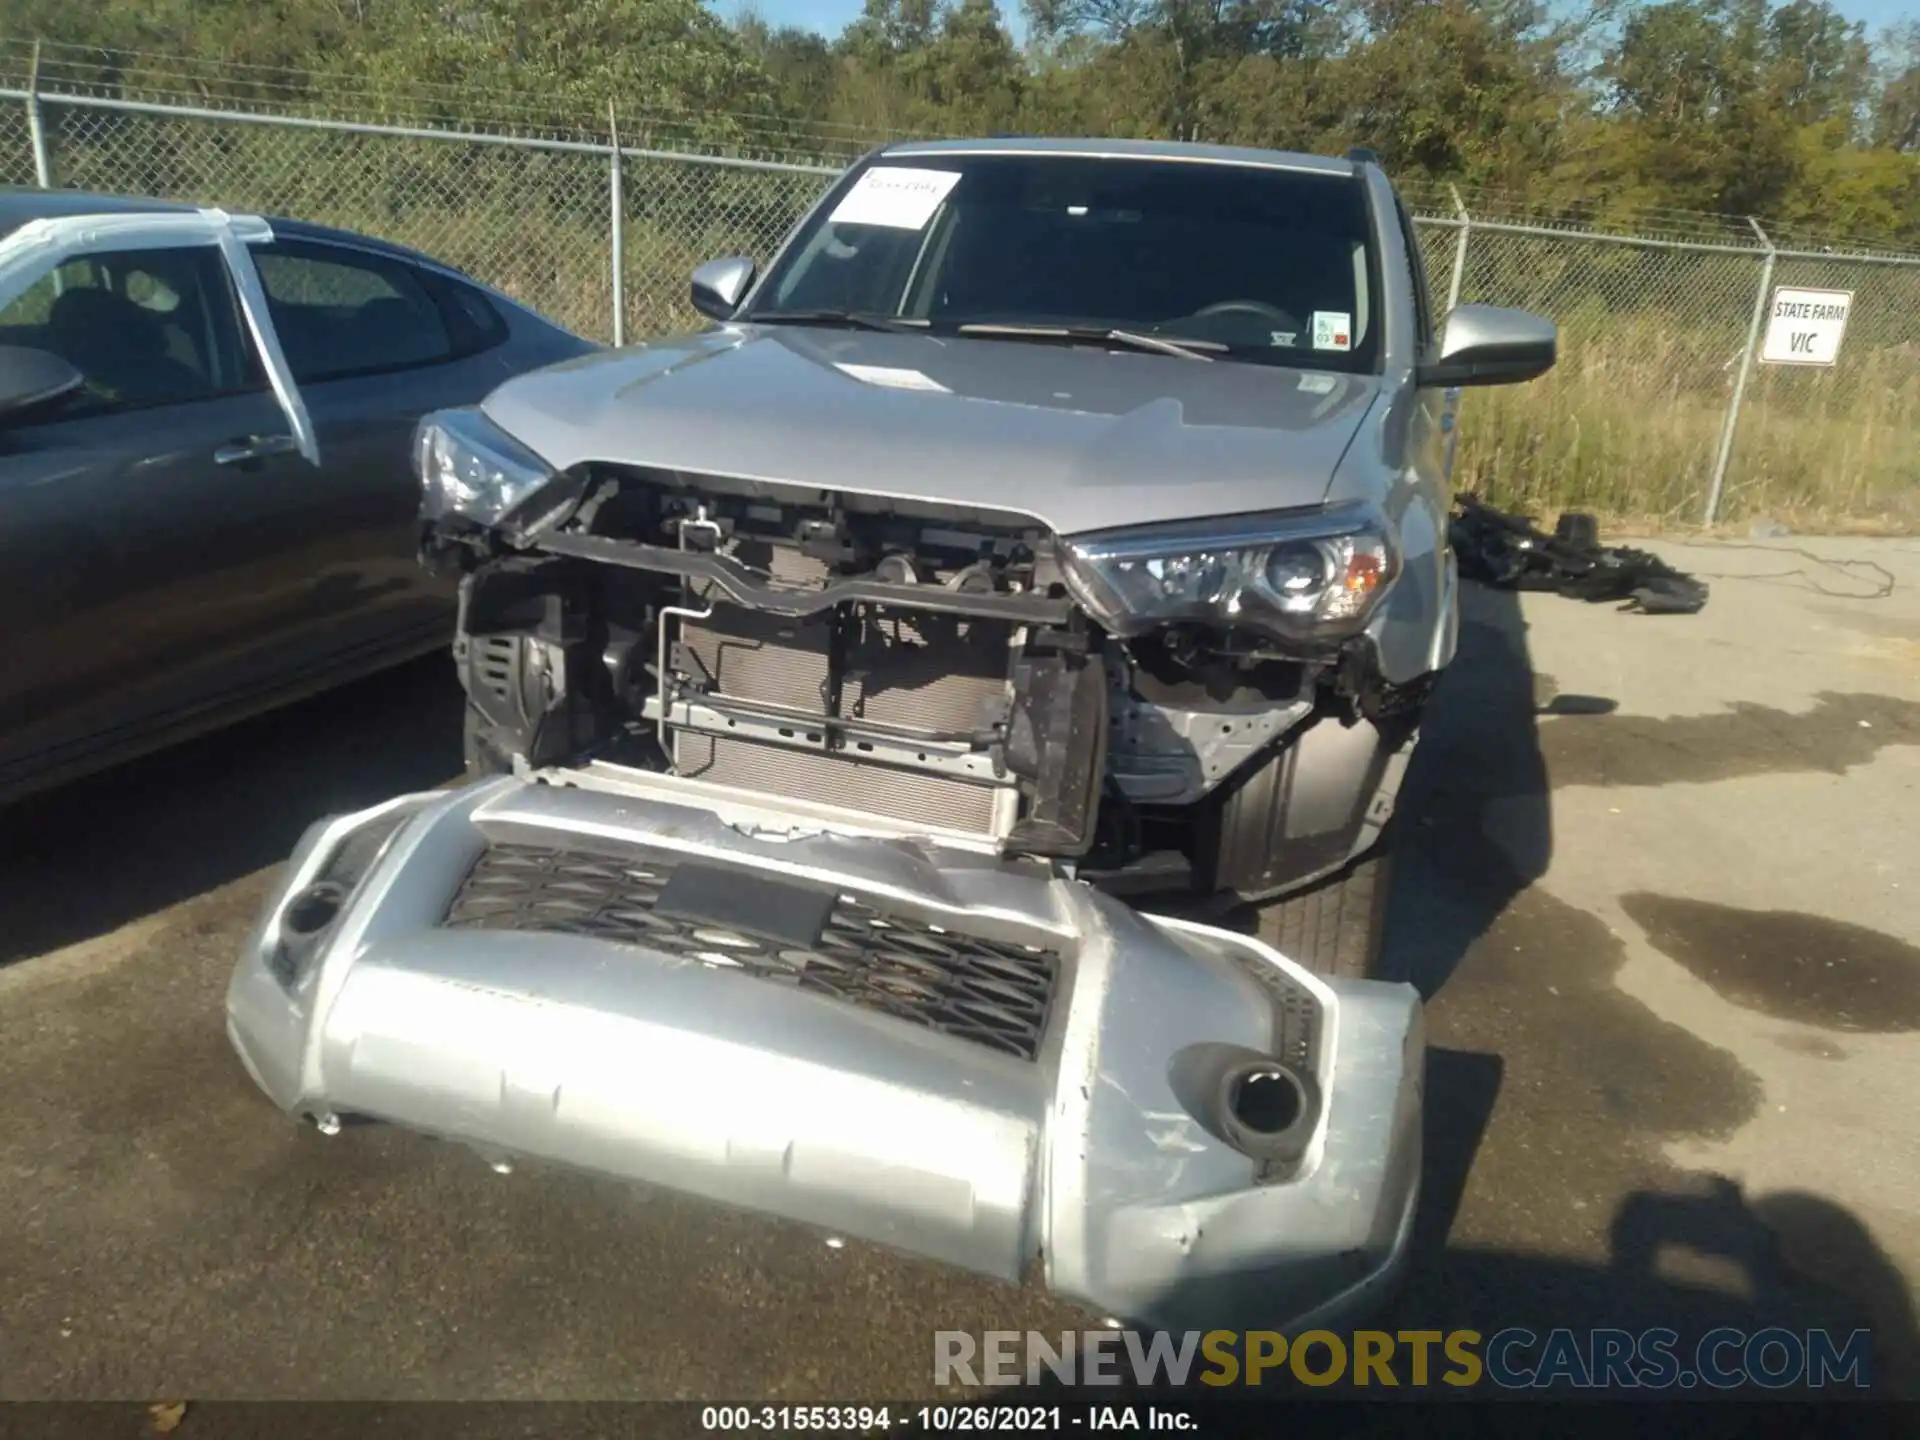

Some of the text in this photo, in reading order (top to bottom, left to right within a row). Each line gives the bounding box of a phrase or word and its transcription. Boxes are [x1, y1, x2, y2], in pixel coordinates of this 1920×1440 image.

[1775, 301, 1845, 321] STATE FARM
[1790, 332, 1818, 353] VIC
